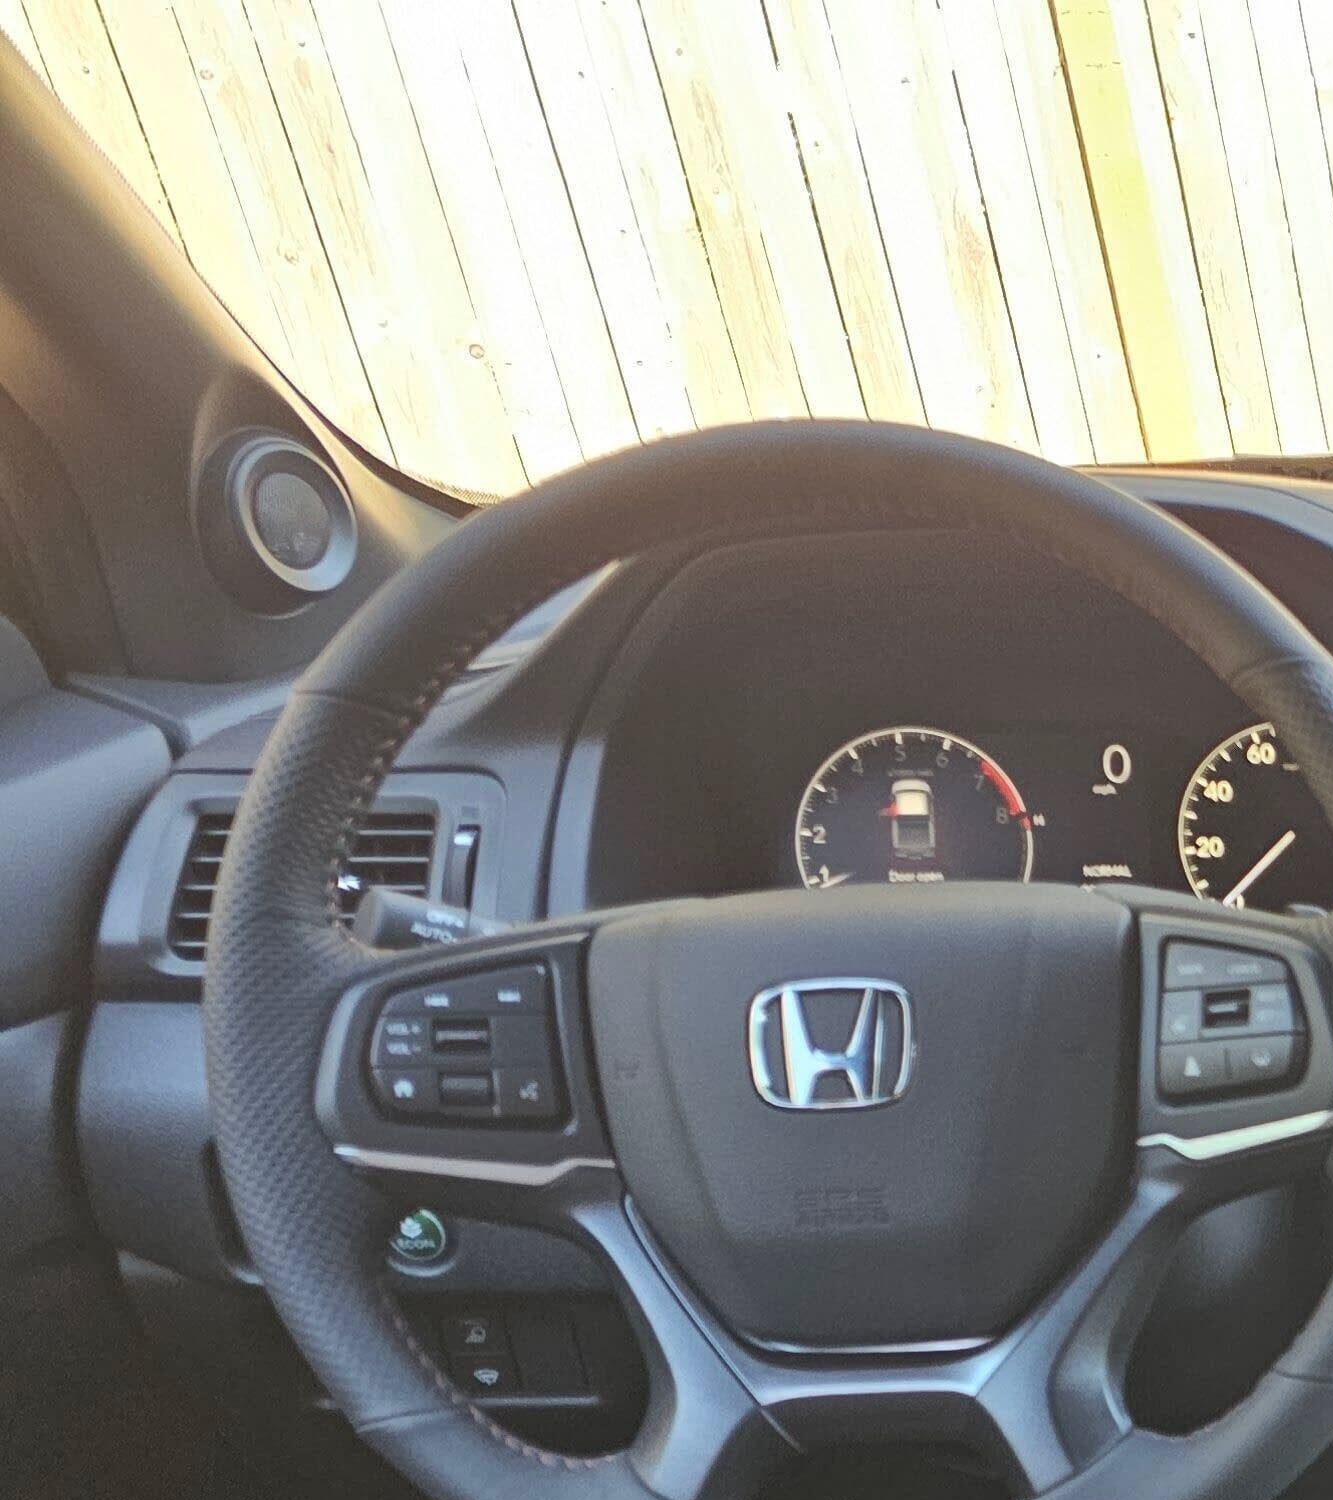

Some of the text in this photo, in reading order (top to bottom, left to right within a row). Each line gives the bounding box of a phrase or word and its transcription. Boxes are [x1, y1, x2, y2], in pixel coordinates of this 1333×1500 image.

[1103, 744, 1132, 784] 0
[1247, 742, 1276, 765] 60
[1204, 780, 1233, 802] 40
[813, 824, 826, 844] 2
[1196, 835, 1225, 858] 20
